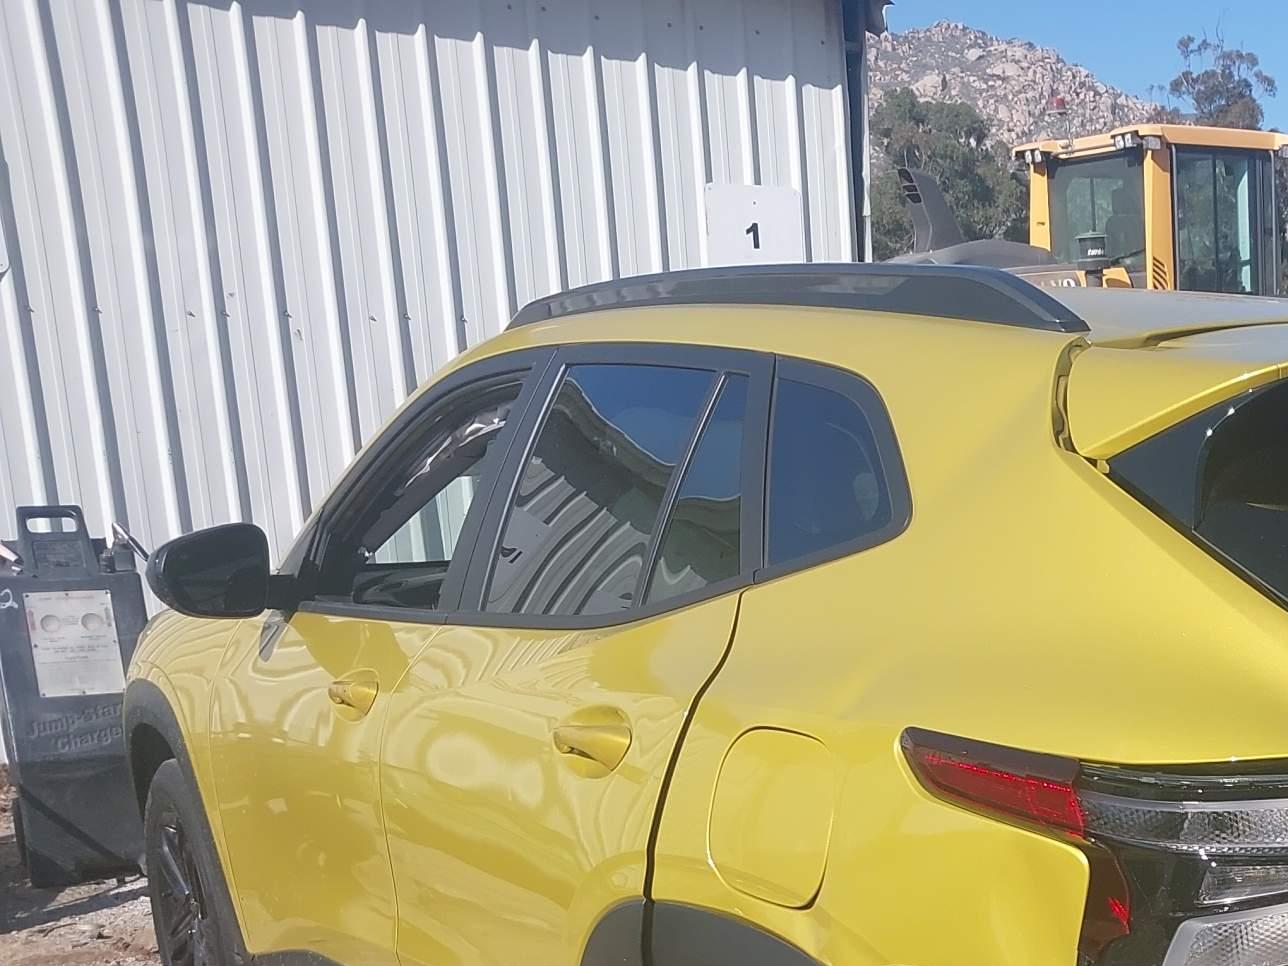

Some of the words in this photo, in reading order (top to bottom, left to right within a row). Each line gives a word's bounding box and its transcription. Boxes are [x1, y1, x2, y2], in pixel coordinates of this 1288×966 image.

[746, 222, 760, 249] 1
[29, 703, 123, 740] Jump-Star
[57, 727, 122, 755] Charge
